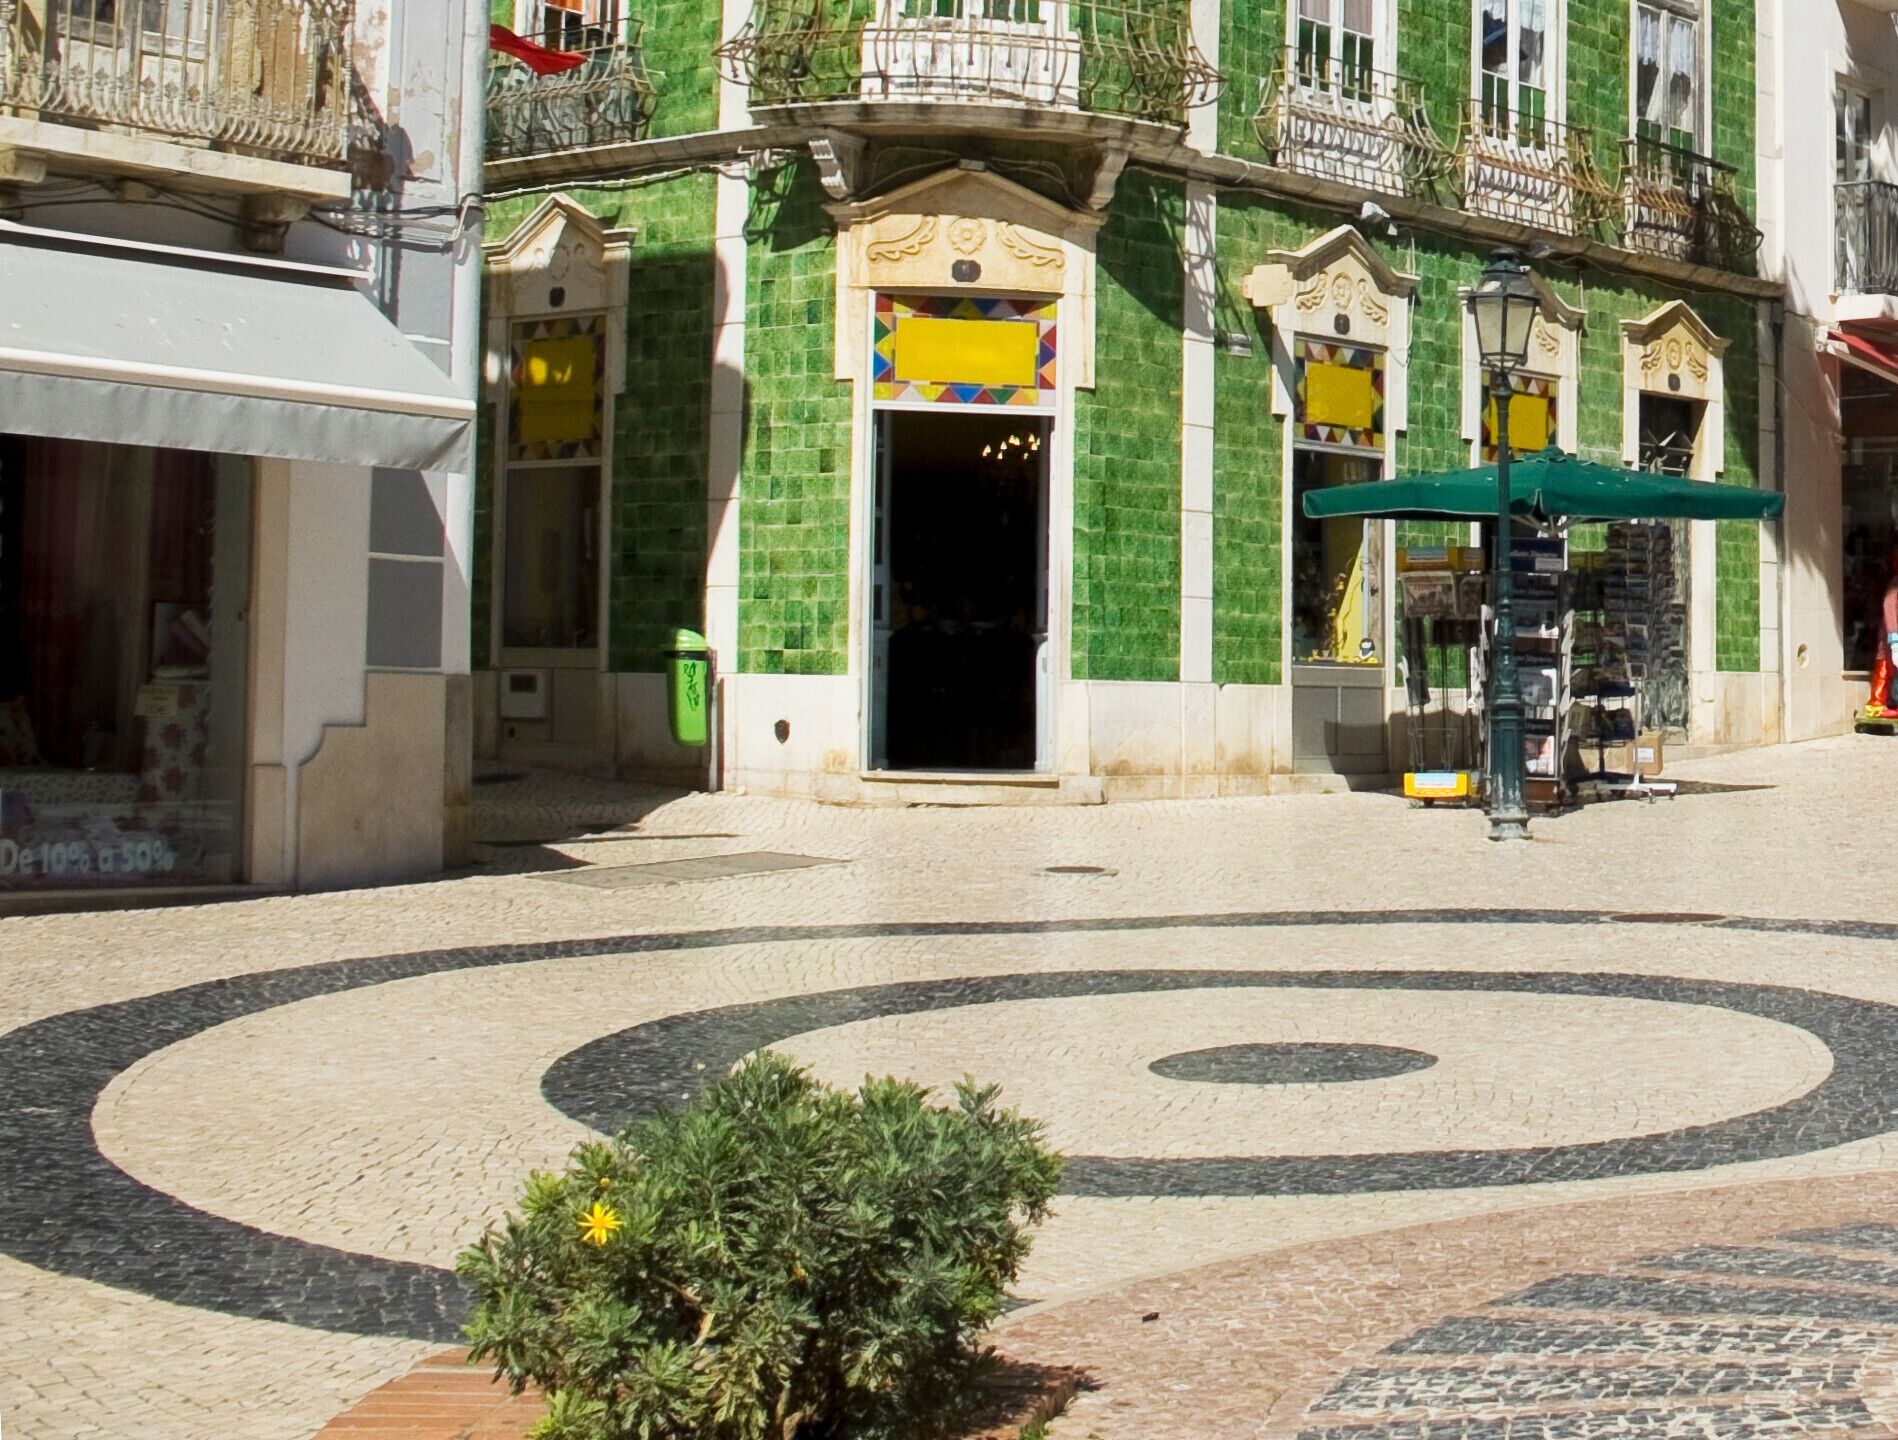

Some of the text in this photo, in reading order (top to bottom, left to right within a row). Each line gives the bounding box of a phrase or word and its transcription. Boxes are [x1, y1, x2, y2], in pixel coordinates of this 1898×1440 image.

[0, 838, 34, 874] De
[41, 841, 90, 873] 10%
[122, 839, 176, 872] 50%
